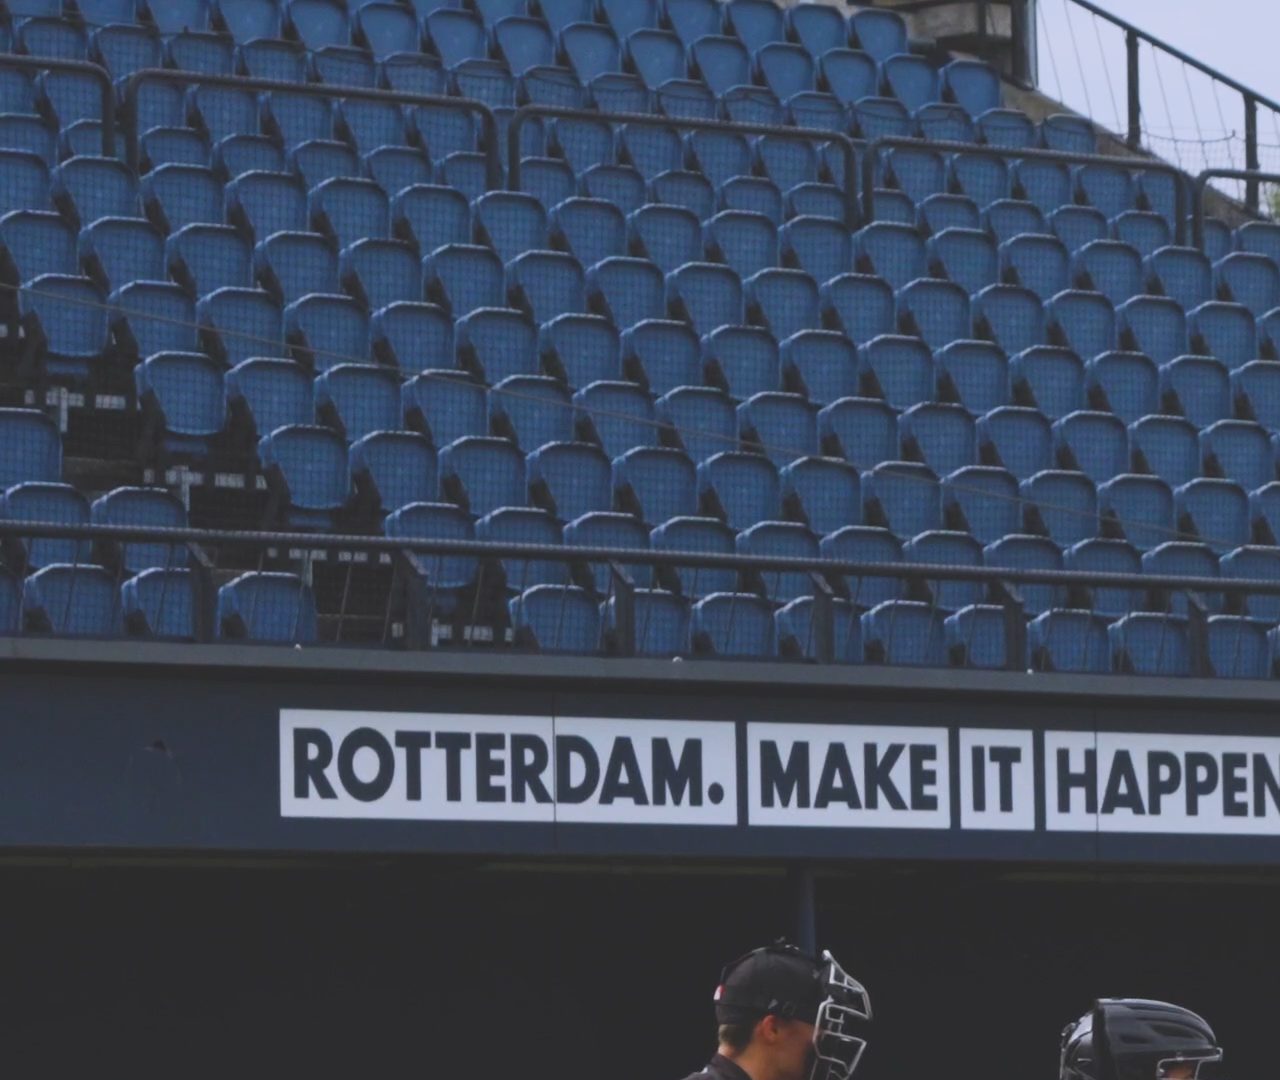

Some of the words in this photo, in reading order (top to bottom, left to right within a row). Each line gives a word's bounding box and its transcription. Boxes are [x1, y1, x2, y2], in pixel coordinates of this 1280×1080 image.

[292, 726, 725, 806] ROTTERDAM.
[759, 739, 939, 811] MAKE
[971, 745, 1022, 812] IT
